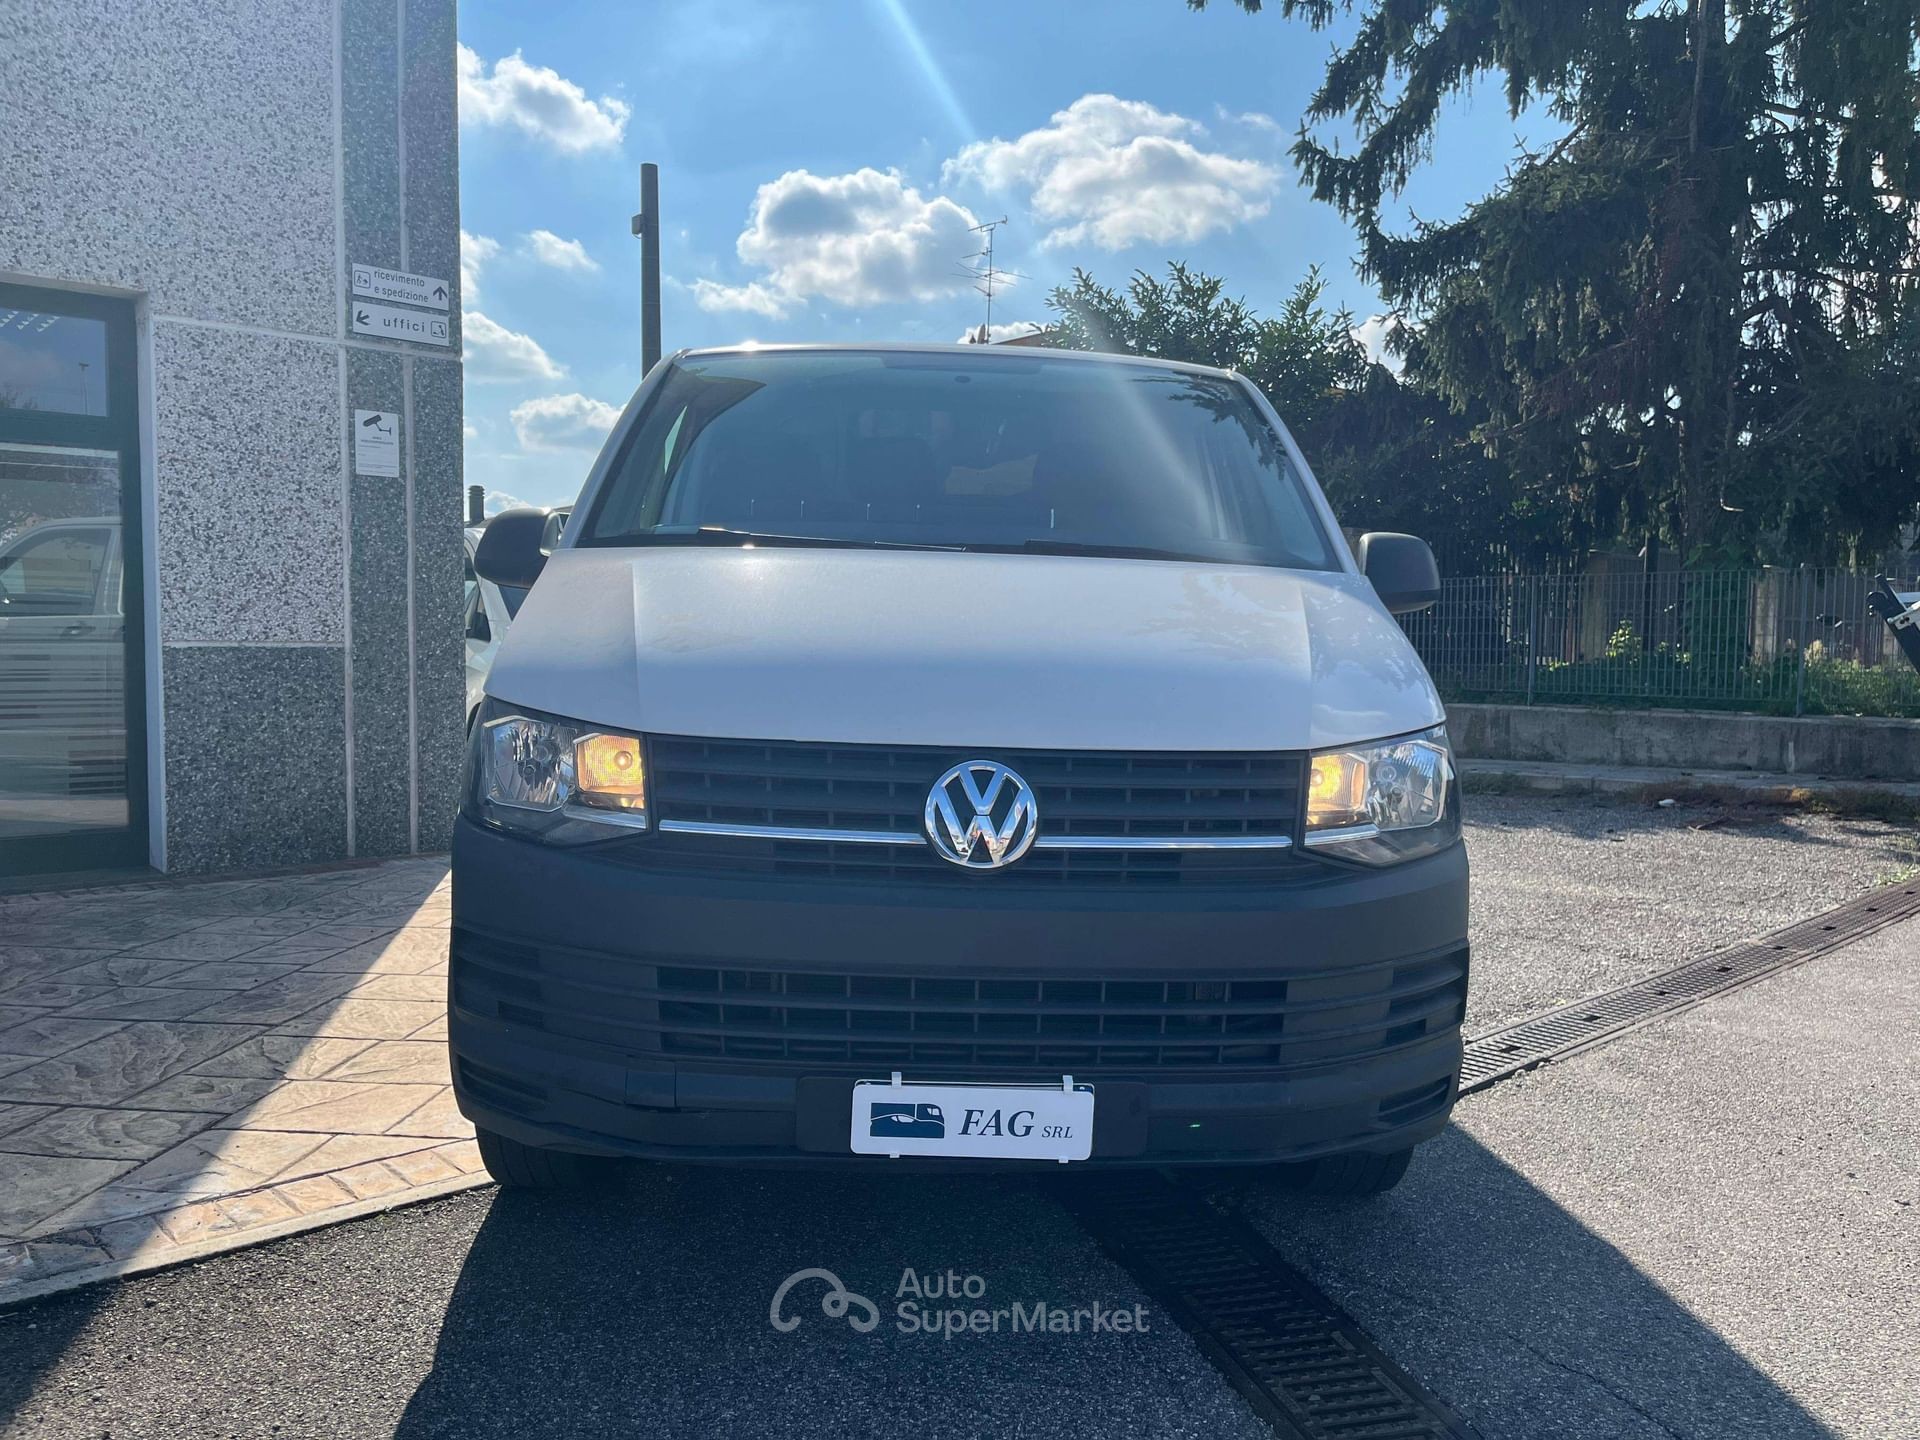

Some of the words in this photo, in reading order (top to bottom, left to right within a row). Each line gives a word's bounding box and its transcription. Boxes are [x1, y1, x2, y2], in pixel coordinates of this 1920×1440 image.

[374, 269, 425, 287] ricevimento
[382, 287, 429, 303] spedizione
[383, 317, 425, 333] uffici
[958, 1109, 1035, 1137] FAG
[1041, 1125, 1073, 1139] SRL
